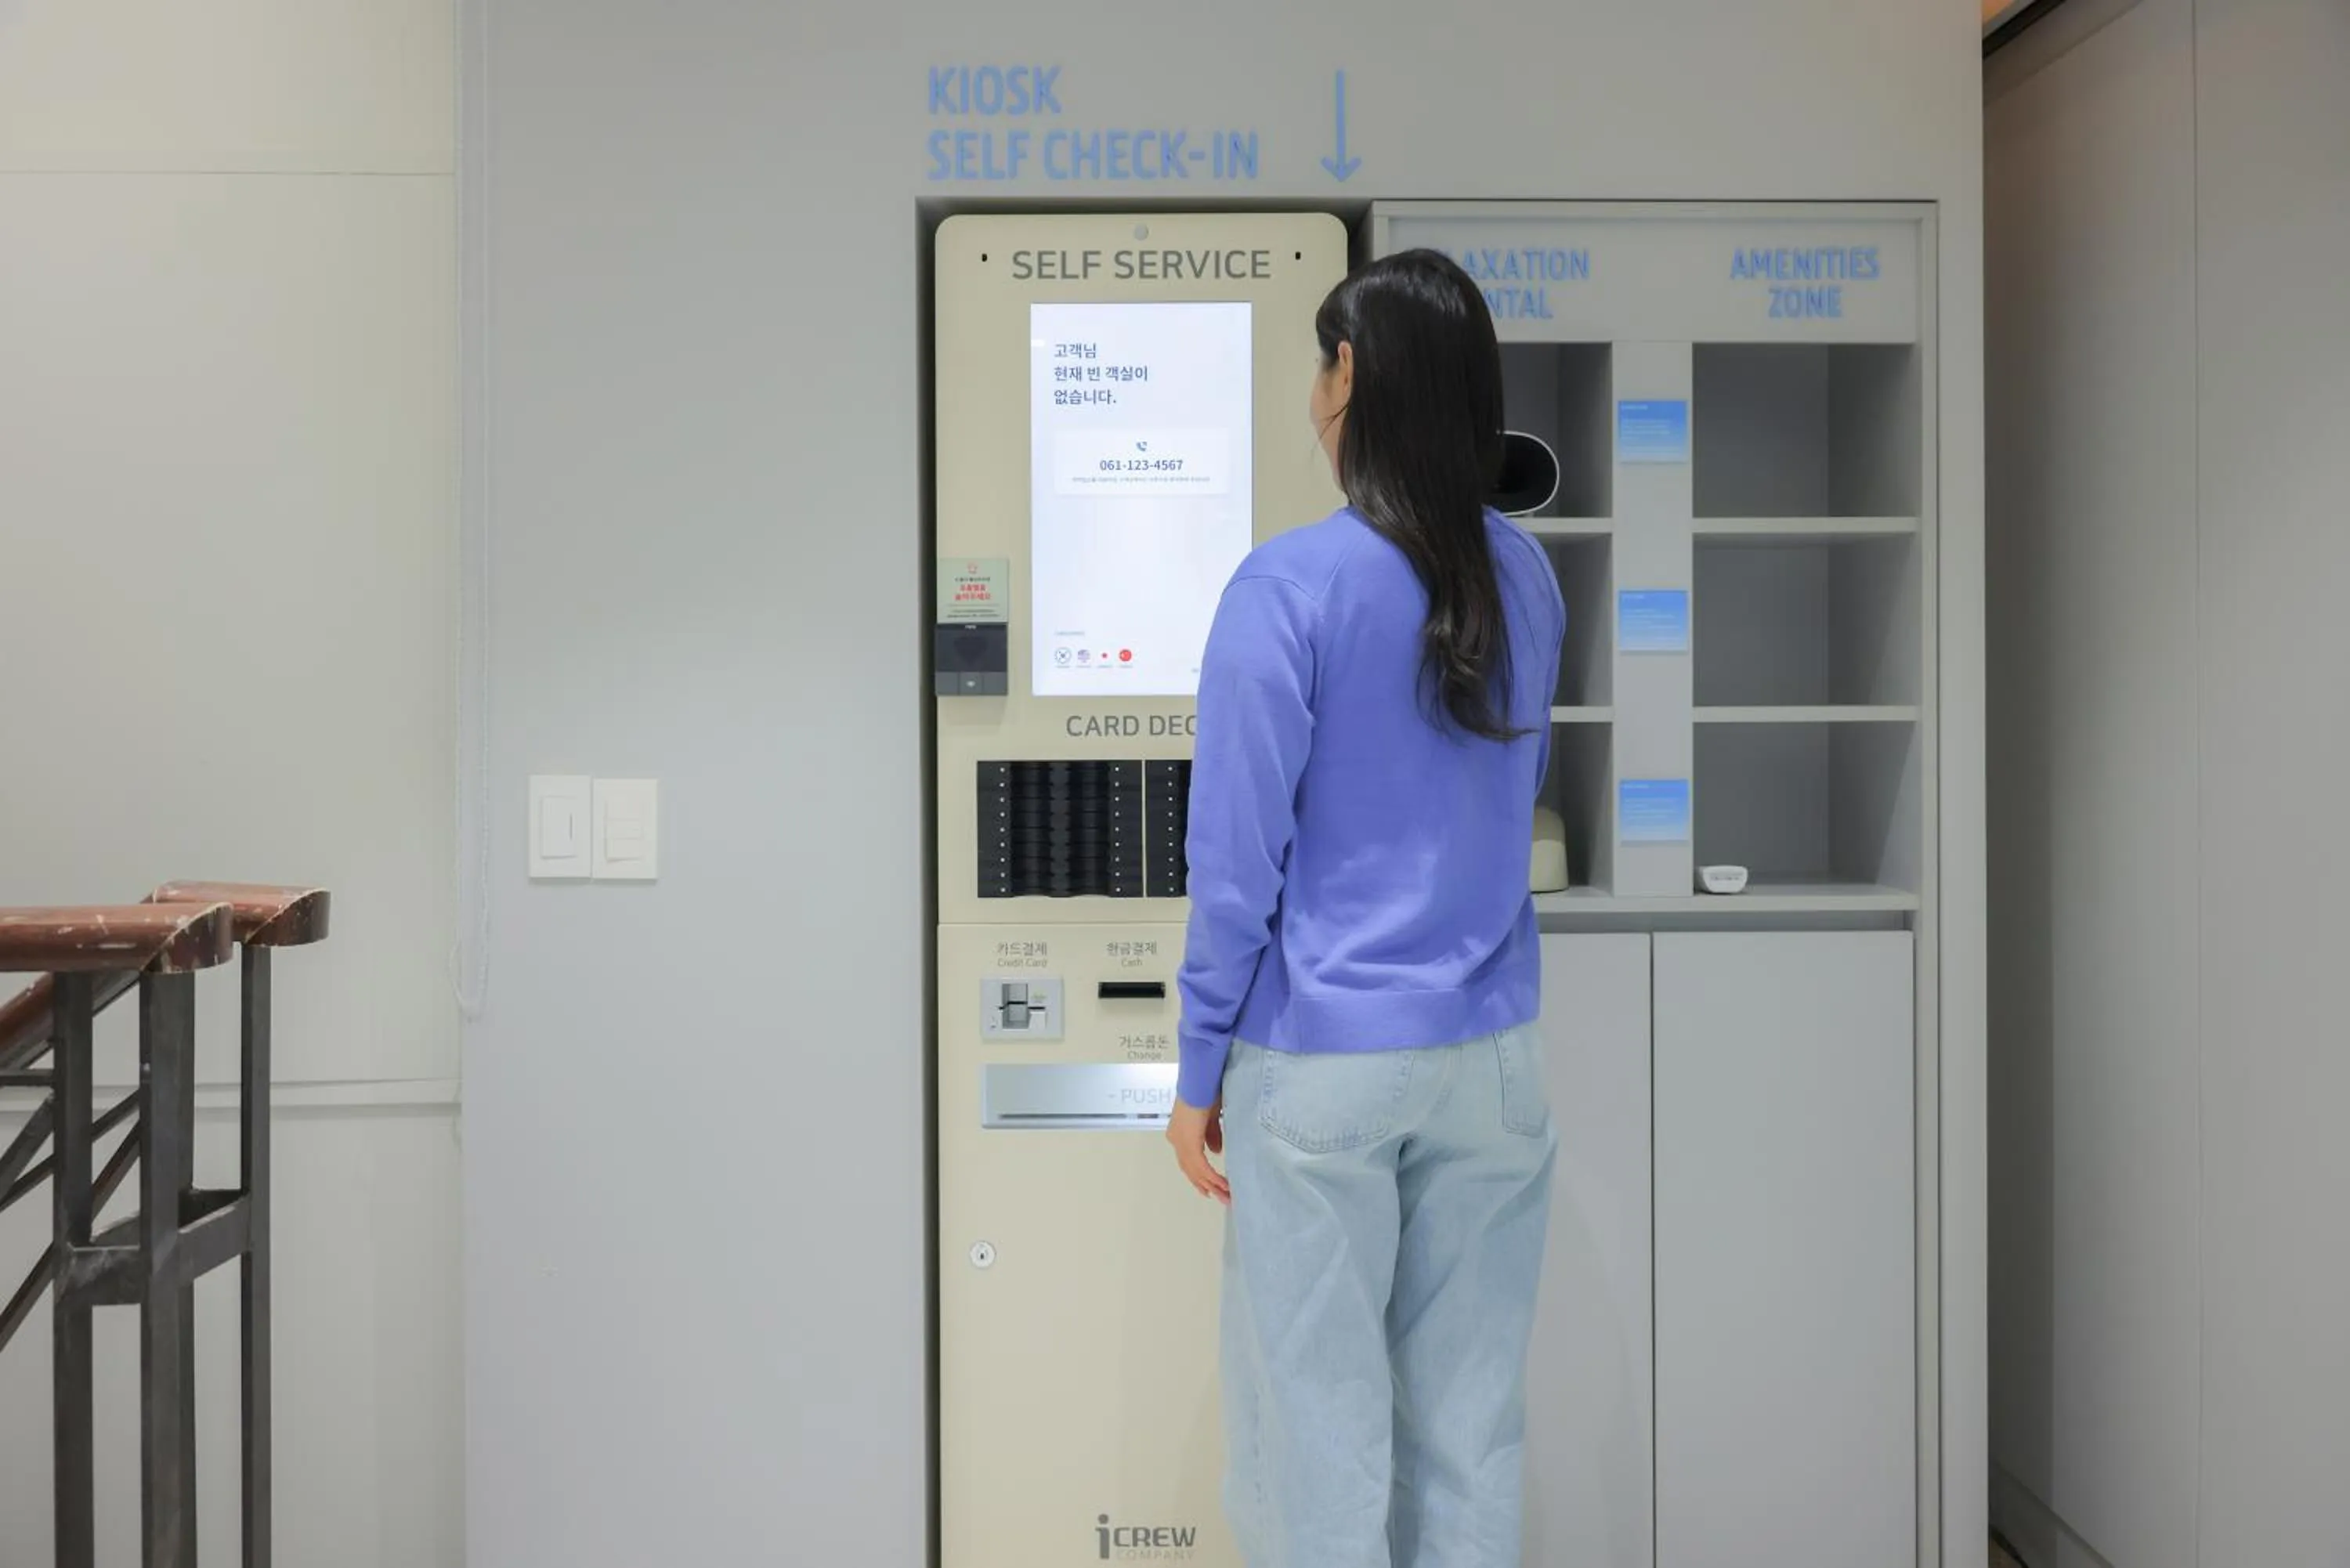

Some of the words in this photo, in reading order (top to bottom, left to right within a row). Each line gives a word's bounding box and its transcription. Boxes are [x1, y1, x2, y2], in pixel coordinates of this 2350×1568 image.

[927, 65, 1062, 115] KIOSK
[927, 130, 1030, 181] SELF
[1043, 130, 1260, 181] CHECK-IN
[1012, 251, 1101, 280] SELF
[1114, 250, 1271, 280] SERVICE
[1462, 247, 1589, 280] AXATION
[1730, 247, 1880, 280] AMENITIES
[1484, 287, 1554, 320] NTAL
[1768, 286, 1842, 318] ZONE
[1054, 343, 1097, 359] 고객님
[1054, 366, 1082, 381] 현재
[1087, 366, 1101, 381] 빈
[1105, 366, 1148, 381] 객실이
[1054, 389, 1117, 405] 없습니다.
[1099, 460, 1184, 471] 061-123-4567
[1066, 715, 1140, 737] CARD
[1149, 714, 1197, 736] DEC
[997, 941, 1047, 956] 카드결제
[1106, 941, 1157, 956] 현금결제
[997, 957, 1023, 967] Credit
[1025, 957, 1047, 967] Card
[1121, 957, 1143, 966] Cash
[1127, 1050, 1162, 1060] Change
[1121, 1087, 1172, 1104] PUSH
[1095, 1513, 1196, 1559] iCREW
[1116, 1548, 1196, 1561] COMPANY
